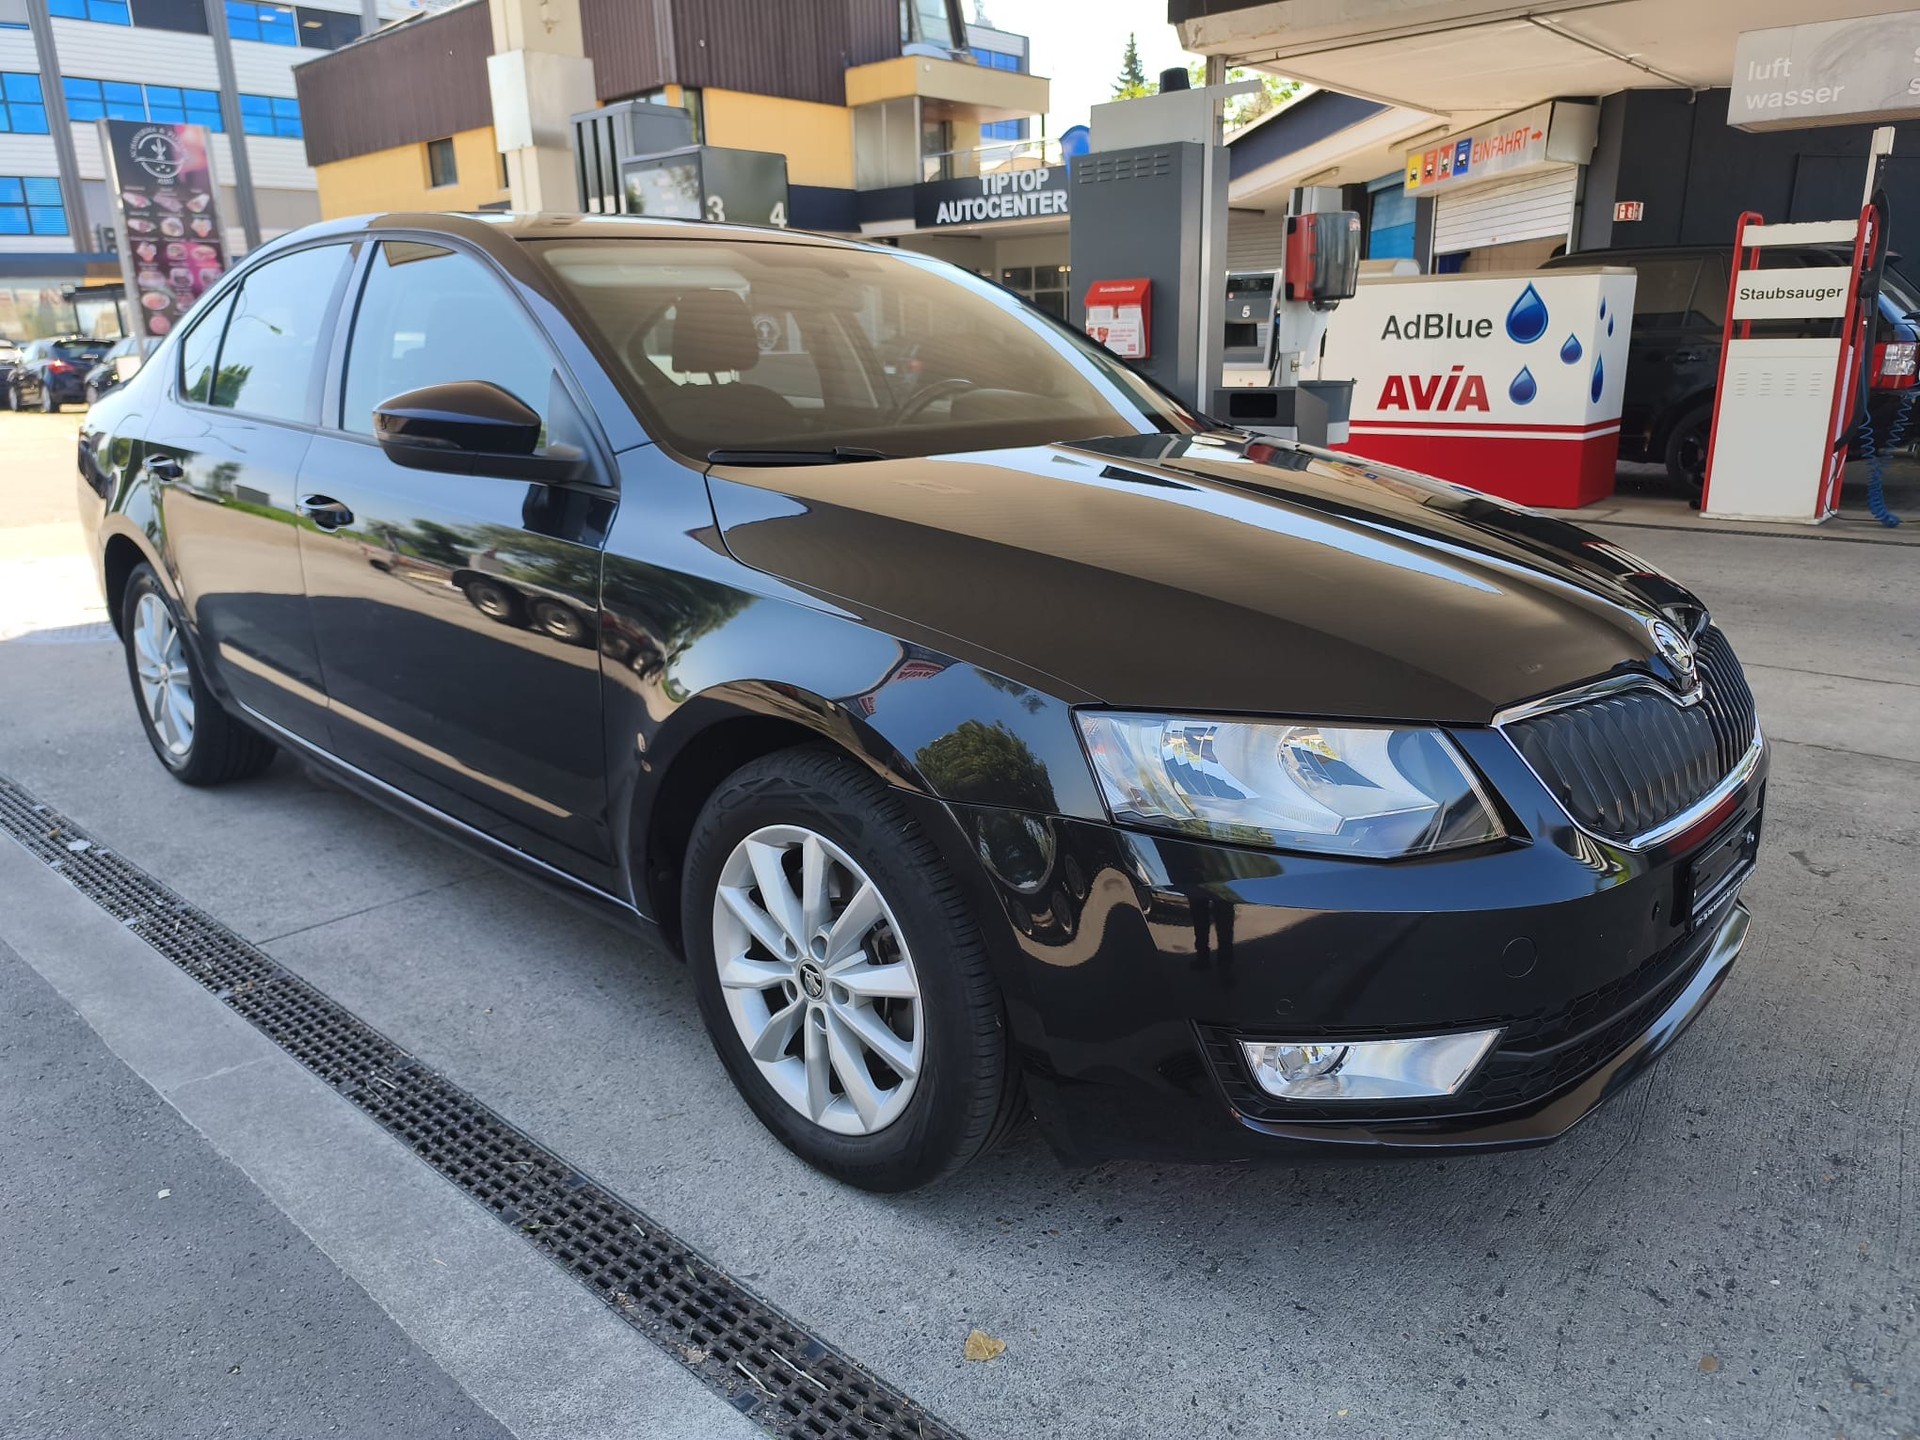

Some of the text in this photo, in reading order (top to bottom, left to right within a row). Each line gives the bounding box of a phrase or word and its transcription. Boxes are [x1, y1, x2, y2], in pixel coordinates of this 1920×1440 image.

[1748, 57, 1792, 81] luft
[1745, 85, 1845, 110] wasser
[1472, 126, 1531, 164] EINFAHRT
[979, 168, 1050, 196] TIPTOP
[706, 195, 726, 223] 3
[769, 201, 788, 229] 4
[936, 189, 1069, 224] AUTOCENTER
[1739, 287, 1844, 302] Staubsauger
[1241, 305, 1251, 318] 5
[1381, 313, 1493, 341] AdBlue
